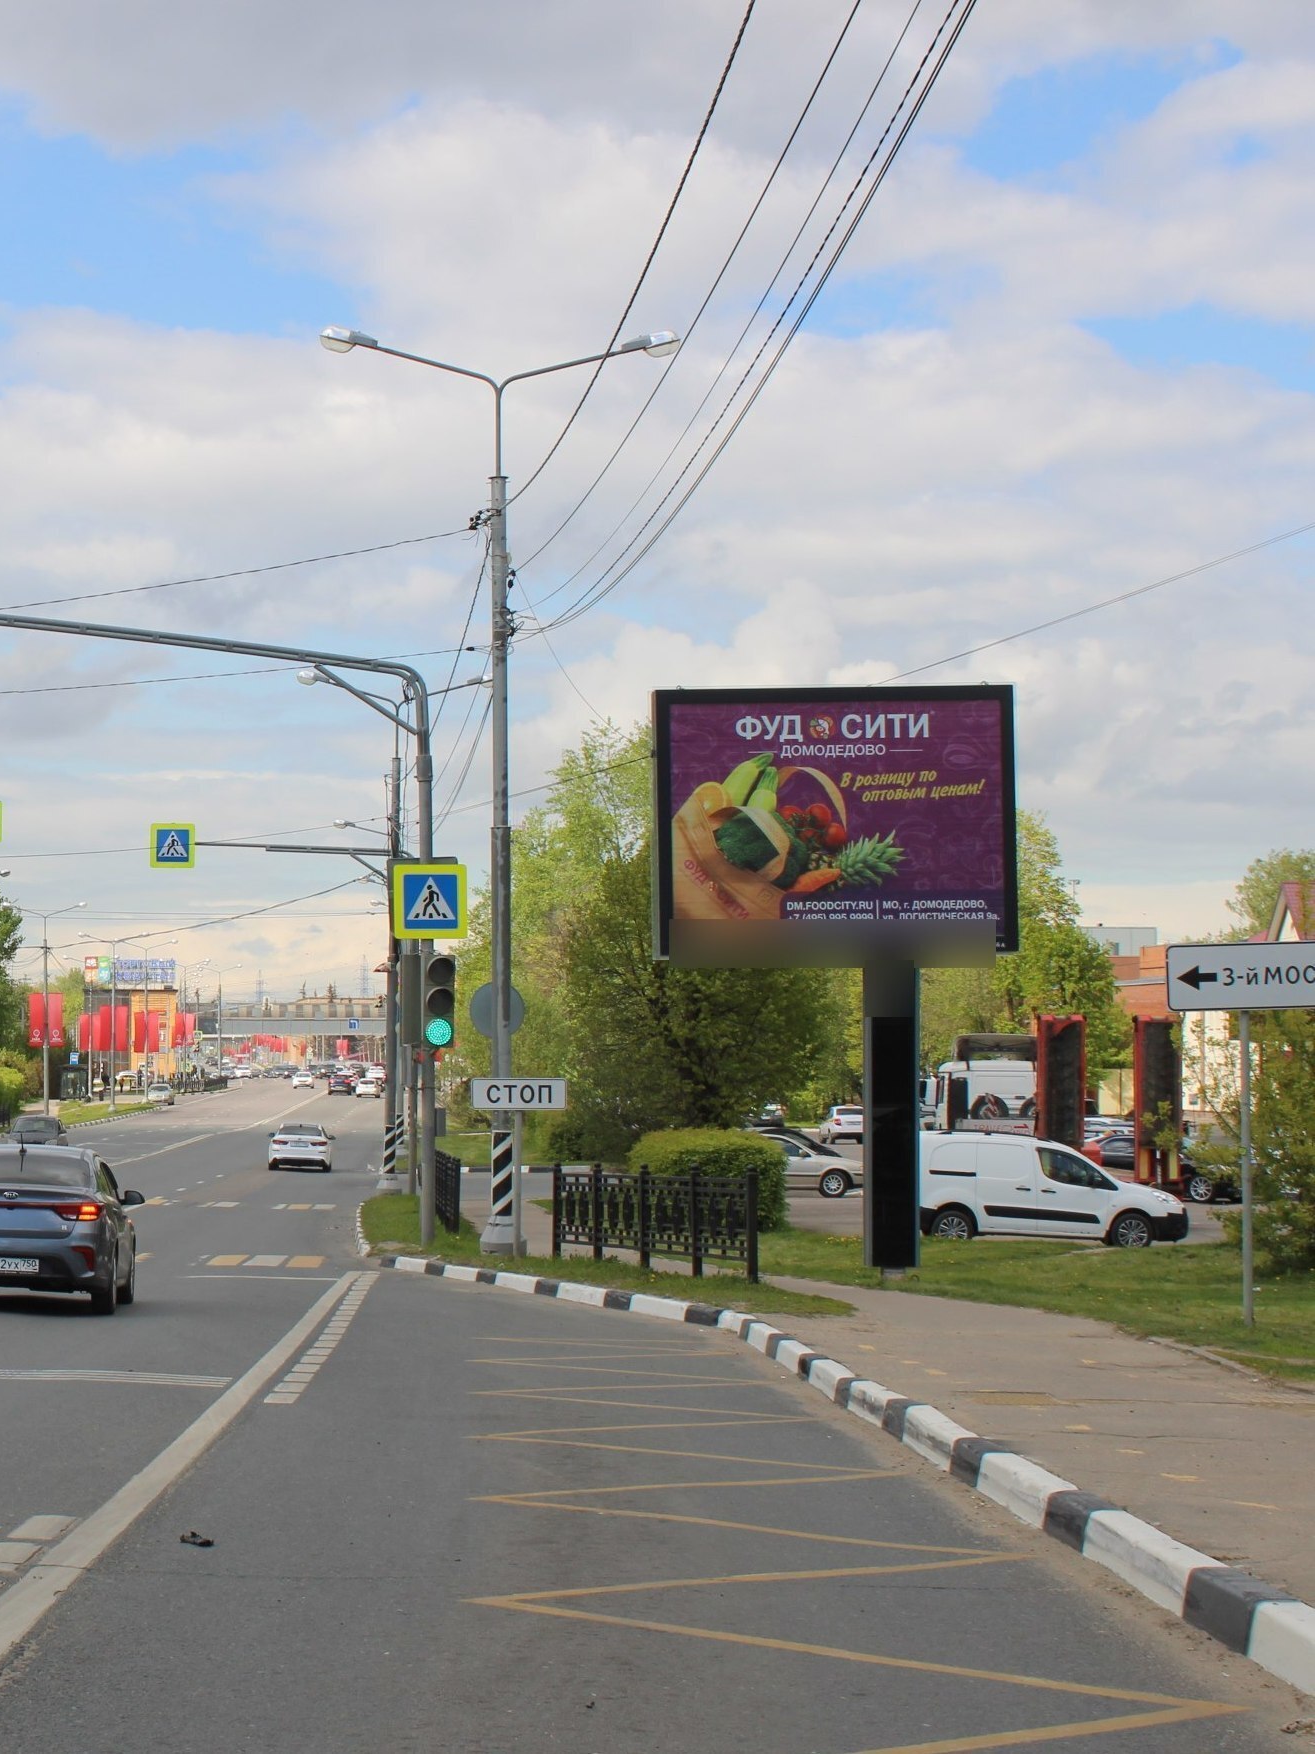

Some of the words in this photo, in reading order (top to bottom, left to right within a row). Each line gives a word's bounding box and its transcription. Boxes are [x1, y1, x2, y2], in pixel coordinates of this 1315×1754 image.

[735, 715, 803, 742] ФУД
[840, 713, 930, 739] СИТИ
[780, 744, 886, 759] ДОМОДЕДОВО
[840, 772, 852, 788] В
[852, 771, 916, 791] розницу
[918, 770, 937, 782] по
[861, 787, 927, 803] оптовым
[930, 778, 986, 800] ценам!
[786, 901, 873, 911] DM.FOODCITY.RU
[883, 901, 902, 910] МО,
[912, 900, 988, 910] ДОМОДЕДОВО,
[1222, 967, 1259, 987] 3-й
[486, 1084, 552, 1104] СТОП
[22, 1259, 37, 1268] 750
